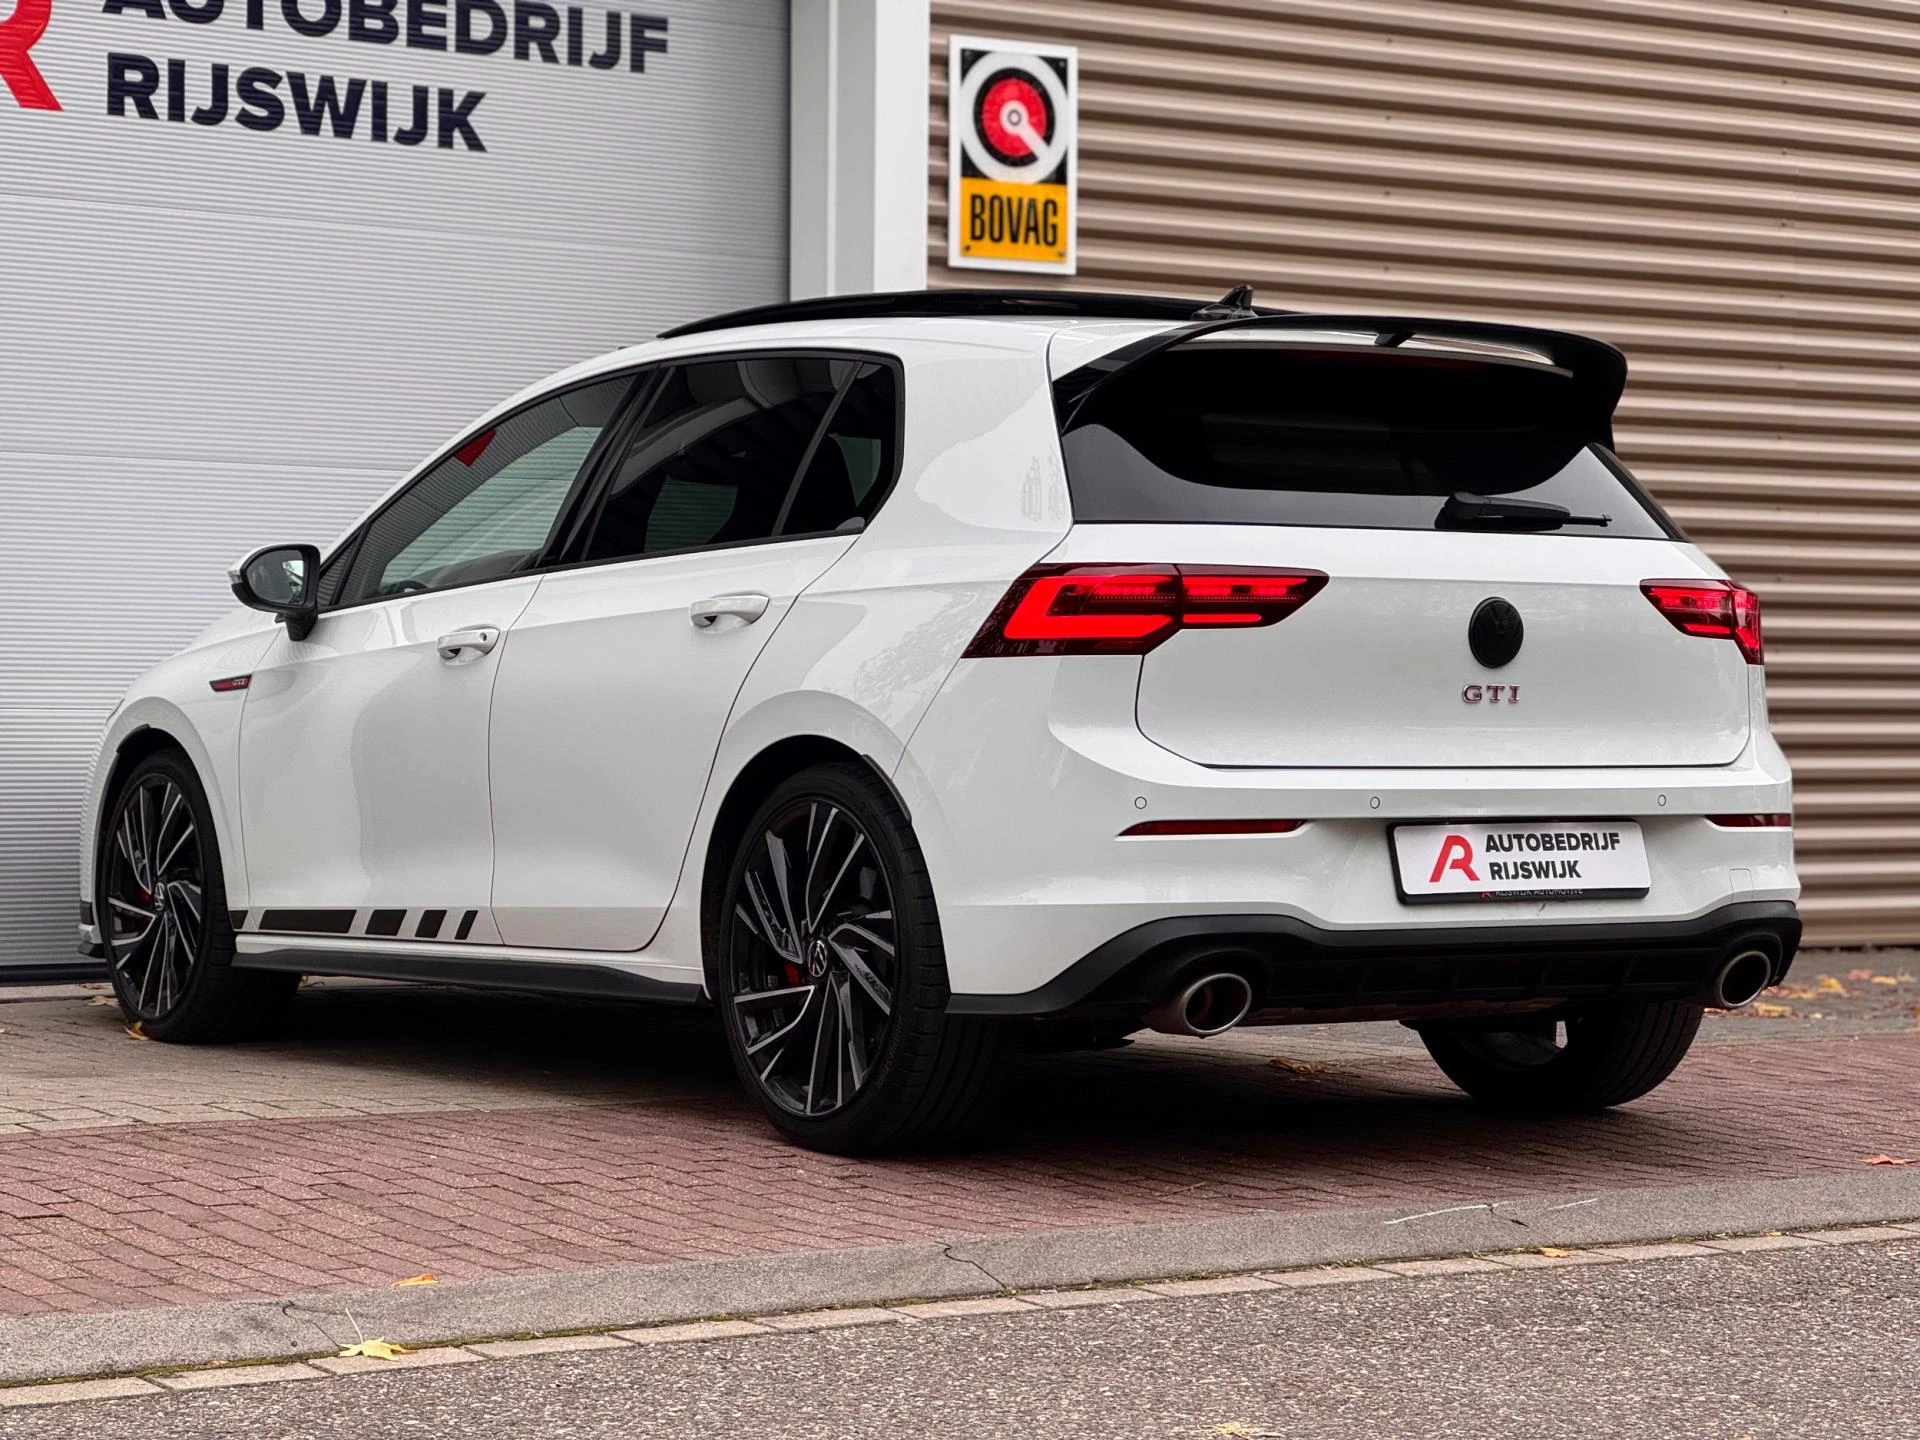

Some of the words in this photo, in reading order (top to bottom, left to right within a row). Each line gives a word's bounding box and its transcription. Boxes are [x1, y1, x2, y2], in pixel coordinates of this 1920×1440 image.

[107, 52, 487, 152] RIJSWIJK
[970, 194, 1058, 247] BOVAG
[1462, 684, 1521, 703] GTI
[1485, 833, 1620, 853] AUTOBEDRIJF
[1489, 860, 1582, 880] RIJSWIJK
